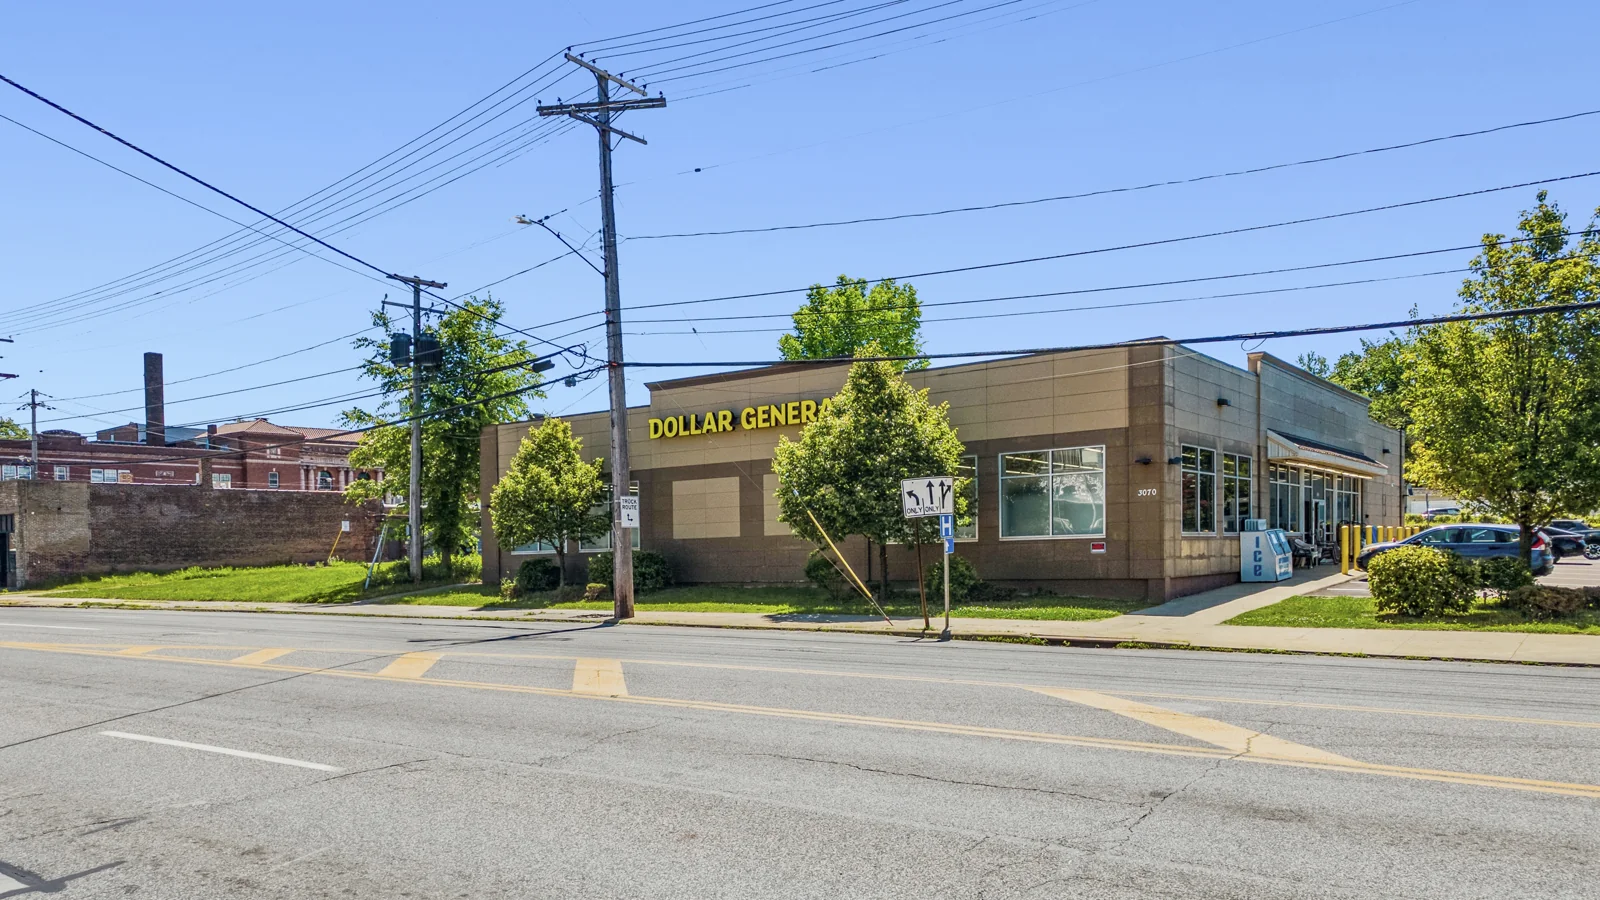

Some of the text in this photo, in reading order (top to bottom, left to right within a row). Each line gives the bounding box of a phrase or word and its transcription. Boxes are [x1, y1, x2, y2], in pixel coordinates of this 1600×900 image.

[649, 398, 834, 439] DOLLAR GENERA
[1137, 488, 1157, 496] 3070
[941, 515, 952, 536] H
